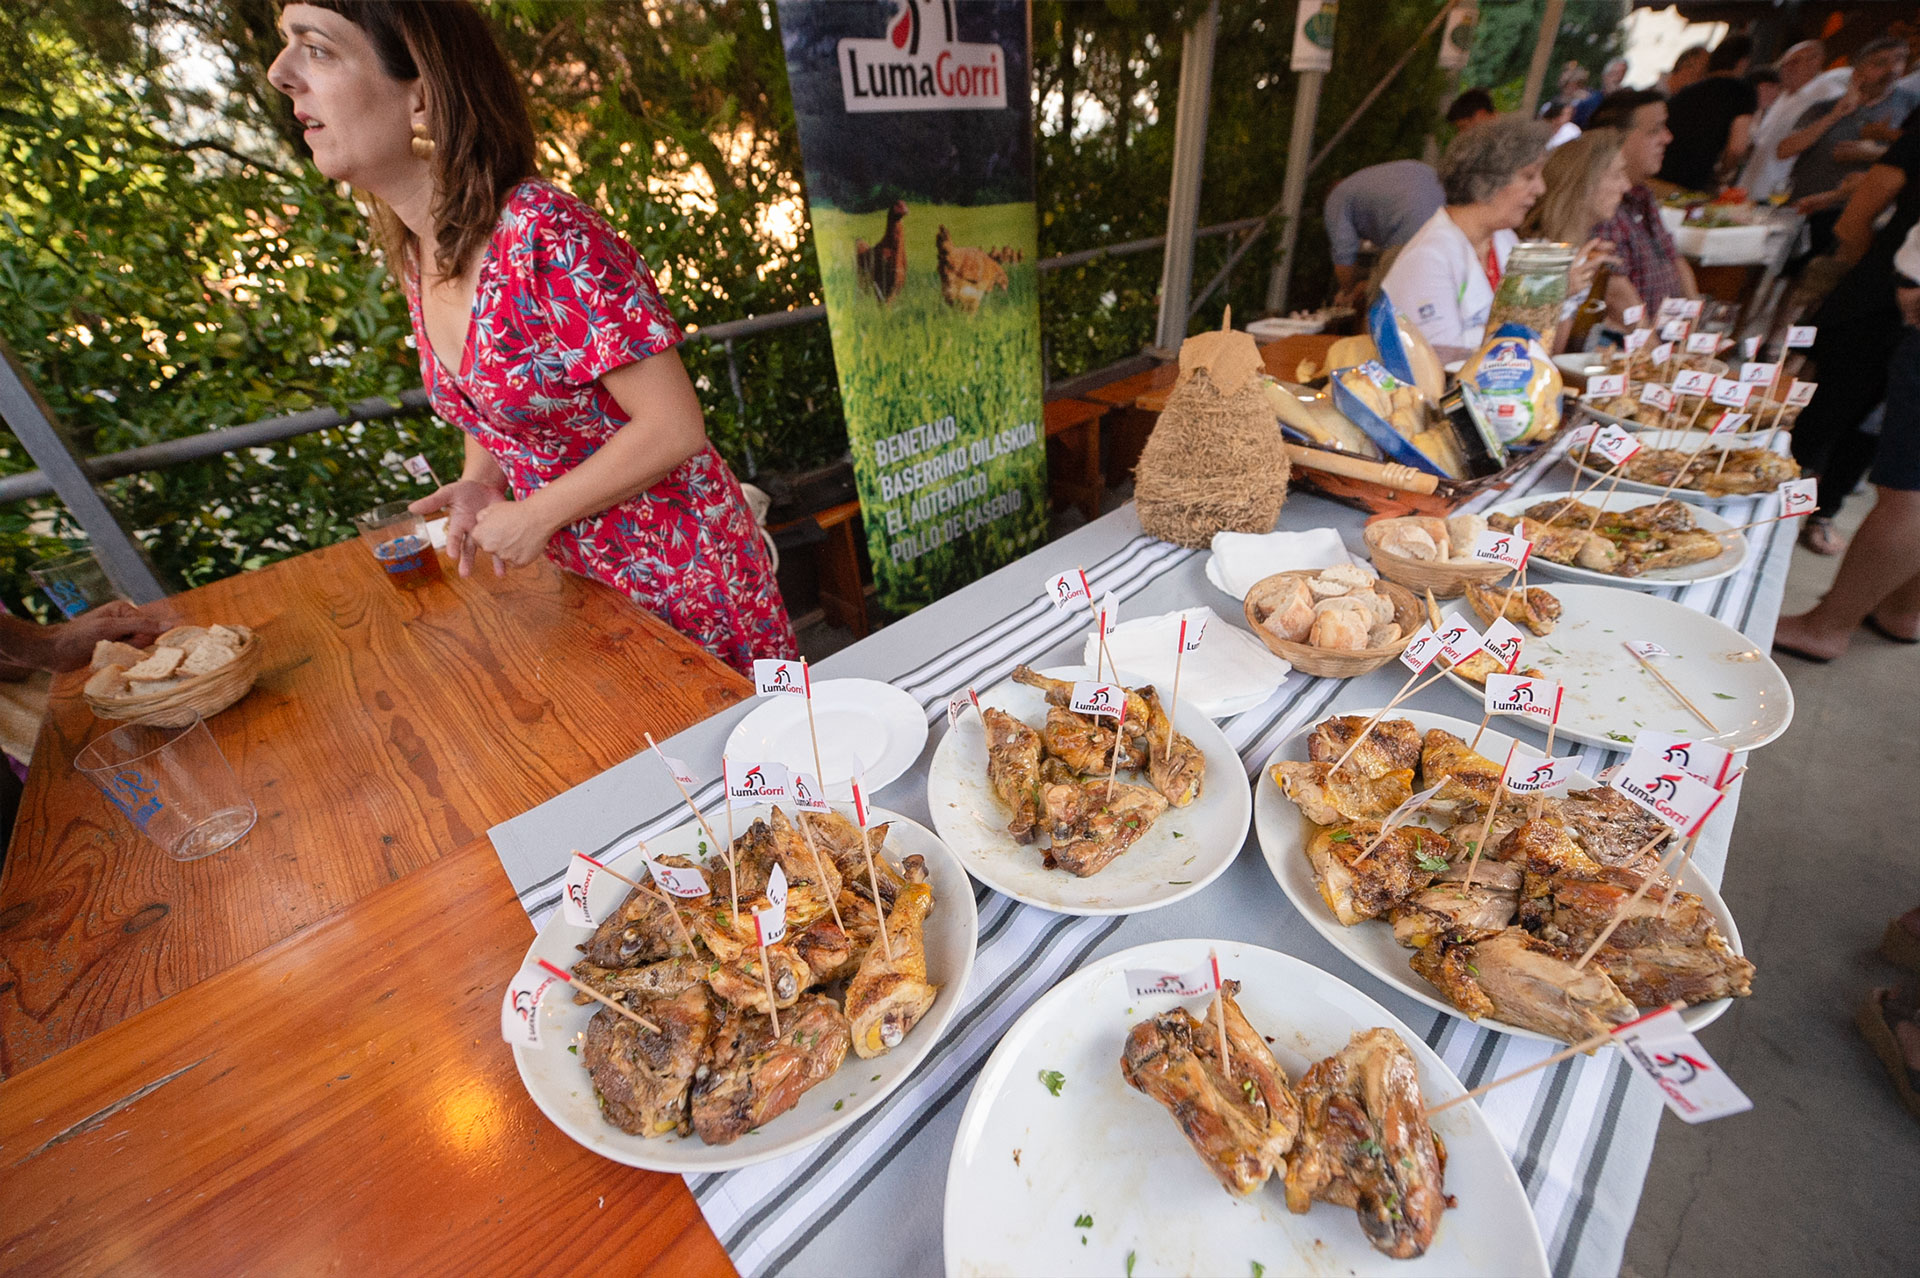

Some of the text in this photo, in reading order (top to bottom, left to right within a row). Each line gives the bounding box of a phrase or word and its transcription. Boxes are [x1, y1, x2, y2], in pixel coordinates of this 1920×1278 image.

[848, 48, 999, 98] LumaGorri
[875, 416, 956, 467] BENETAKO
[881, 422, 1037, 502] BASERRIKO OILASKOA
[886, 508, 907, 536] EL
[890, 526, 940, 567] POLLO
[943, 514, 962, 543] DE
[1476, 549, 1519, 566] LumaGorri
[763, 683, 804, 694] LumaGorri
[1075, 701, 1121, 716] LumaGorri
[1493, 700, 1551, 717] LumaGorri
[731, 786, 784, 797] LumaGorri
[1507, 777, 1567, 791] LumaGorri
[1620, 777, 1690, 826] LumaGorri
[582, 868, 595, 924] LumaGorri
